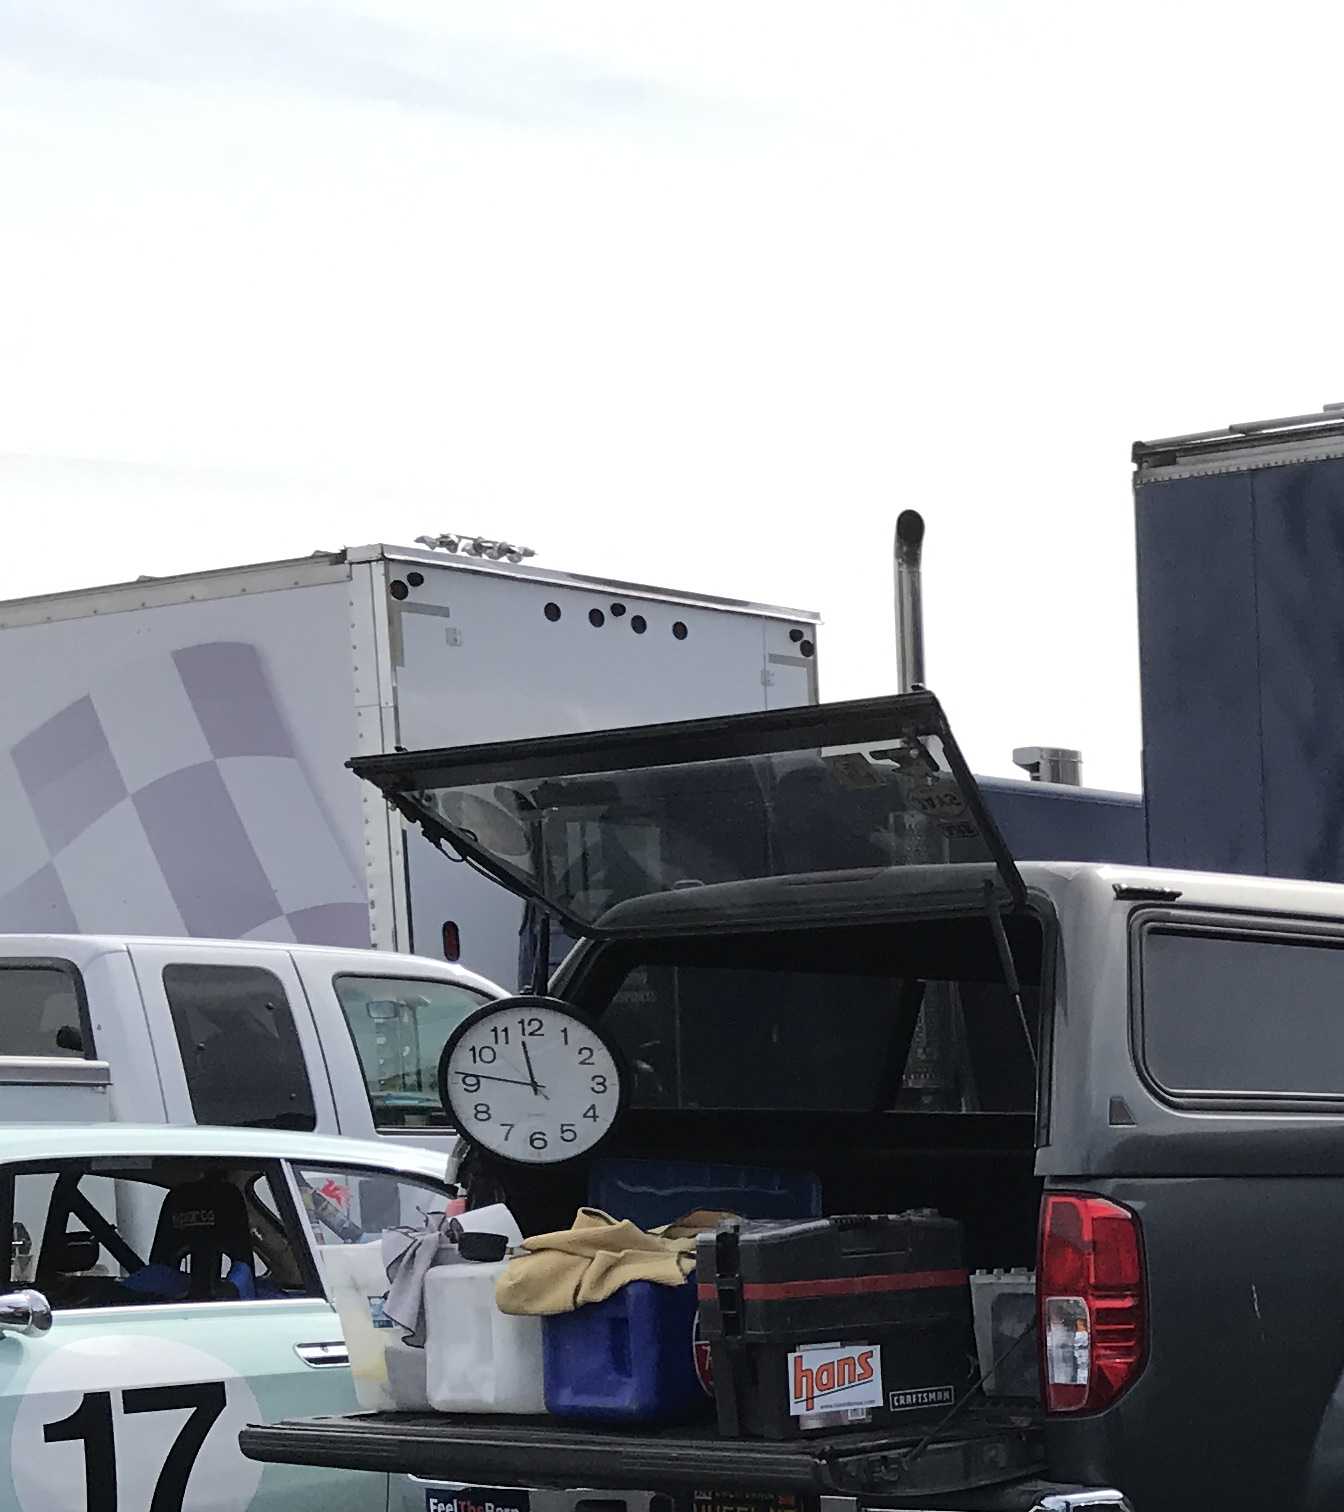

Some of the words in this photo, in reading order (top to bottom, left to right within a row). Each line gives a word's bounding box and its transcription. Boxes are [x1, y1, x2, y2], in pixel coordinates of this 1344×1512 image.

[490, 1026, 510, 1045] 11
[517, 1018, 545, 1037] 12
[560, 1027, 569, 1046] 1
[469, 1045, 497, 1065] 10
[578, 1047, 595, 1065] 2
[461, 1074, 481, 1094] 9
[590, 1075, 608, 1094] 3
[473, 1103, 492, 1122] 8
[582, 1103, 600, 1122] 4
[500, 1123, 515, 1141] 7
[529, 1131, 548, 1150] 6
[560, 1123, 577, 1143] 5
[794, 1350, 874, 1412] hans
[893, 1390, 951, 1407] CRAFTSMAN
